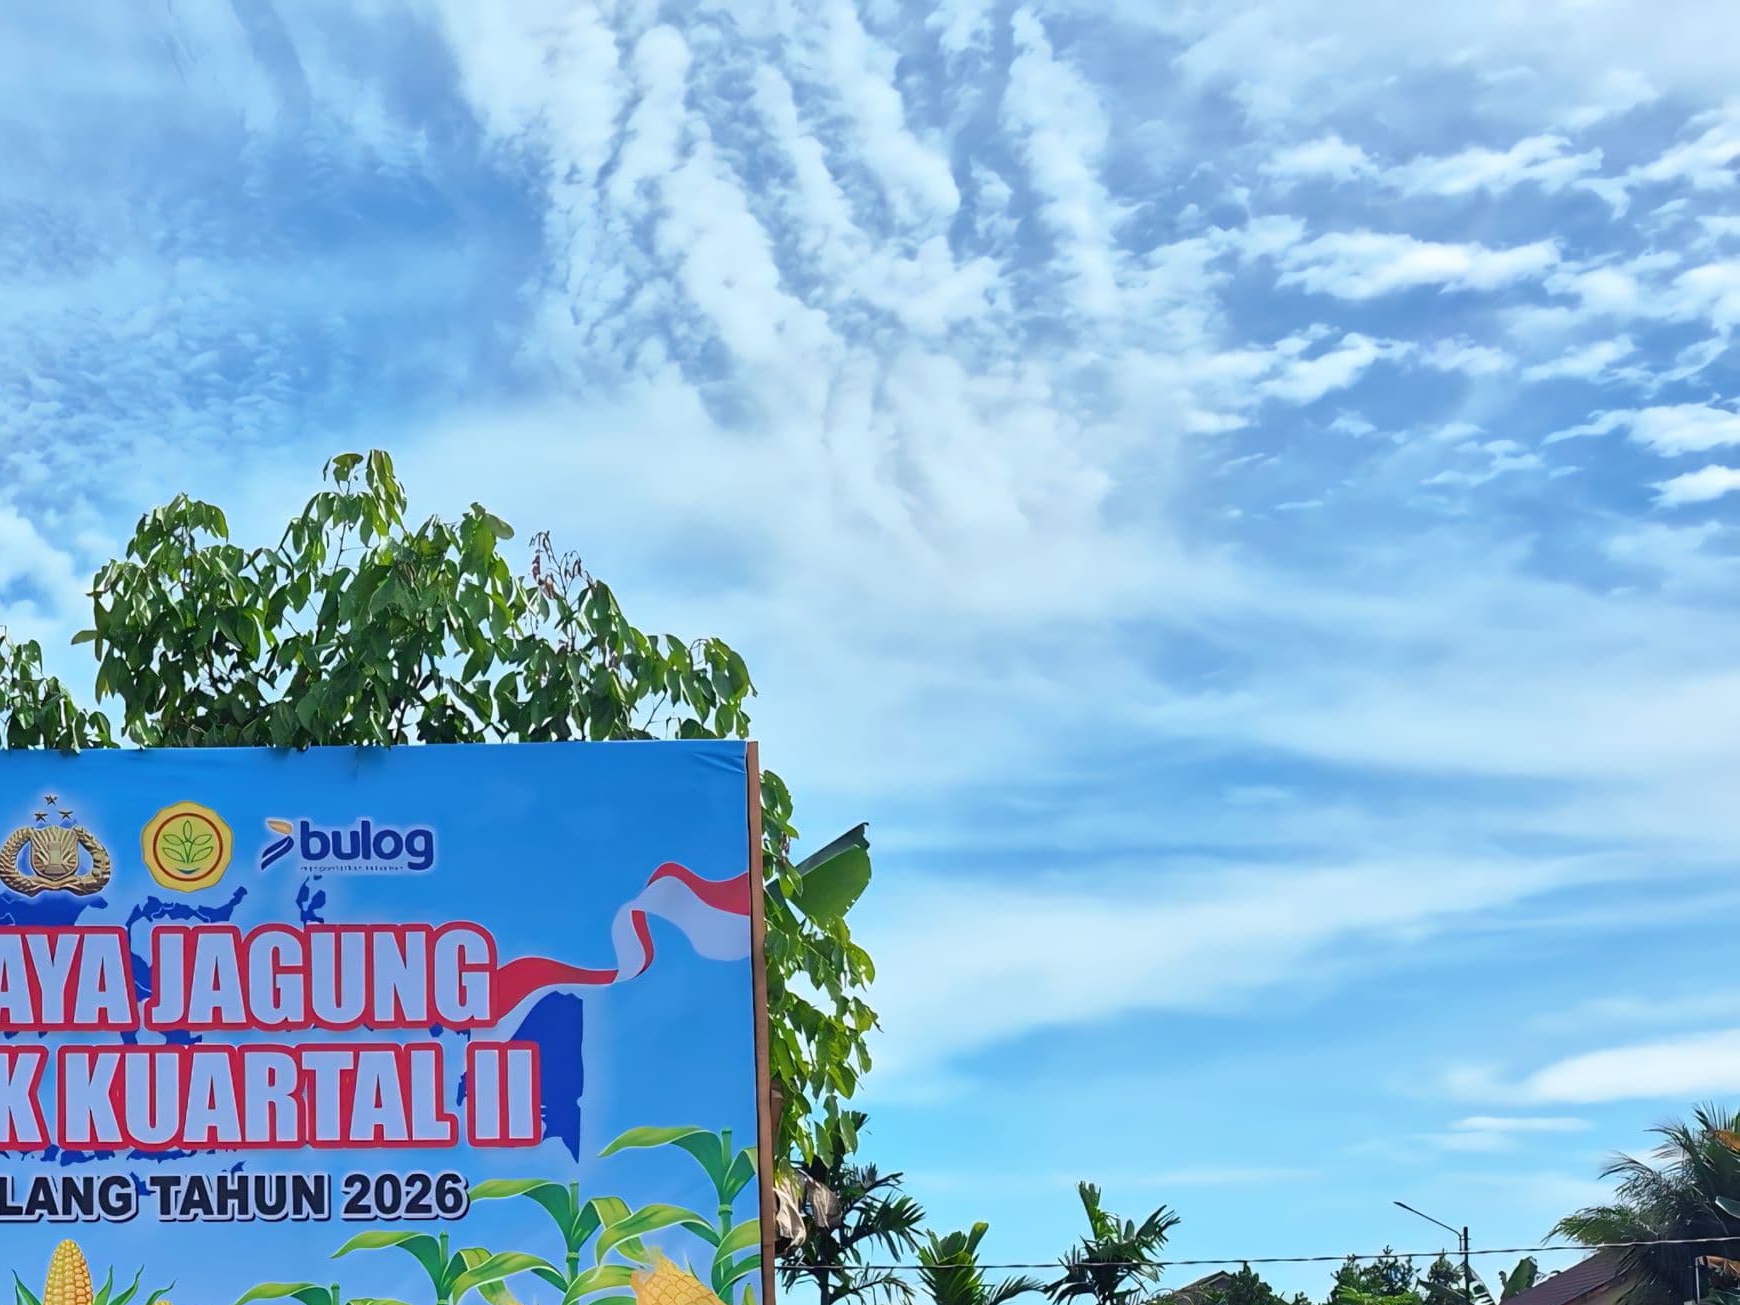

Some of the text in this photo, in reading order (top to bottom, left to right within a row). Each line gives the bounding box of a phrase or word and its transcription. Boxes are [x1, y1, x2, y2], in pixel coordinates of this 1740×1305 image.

[299, 819, 434, 871] bulog
[150, 928, 492, 1025] JAGUNG
[63, 1048, 452, 1144] KUARTAL
[473, 1048, 535, 1140] II
[149, 1174, 327, 1219] TAHUN
[342, 1173, 466, 1218] 2026
